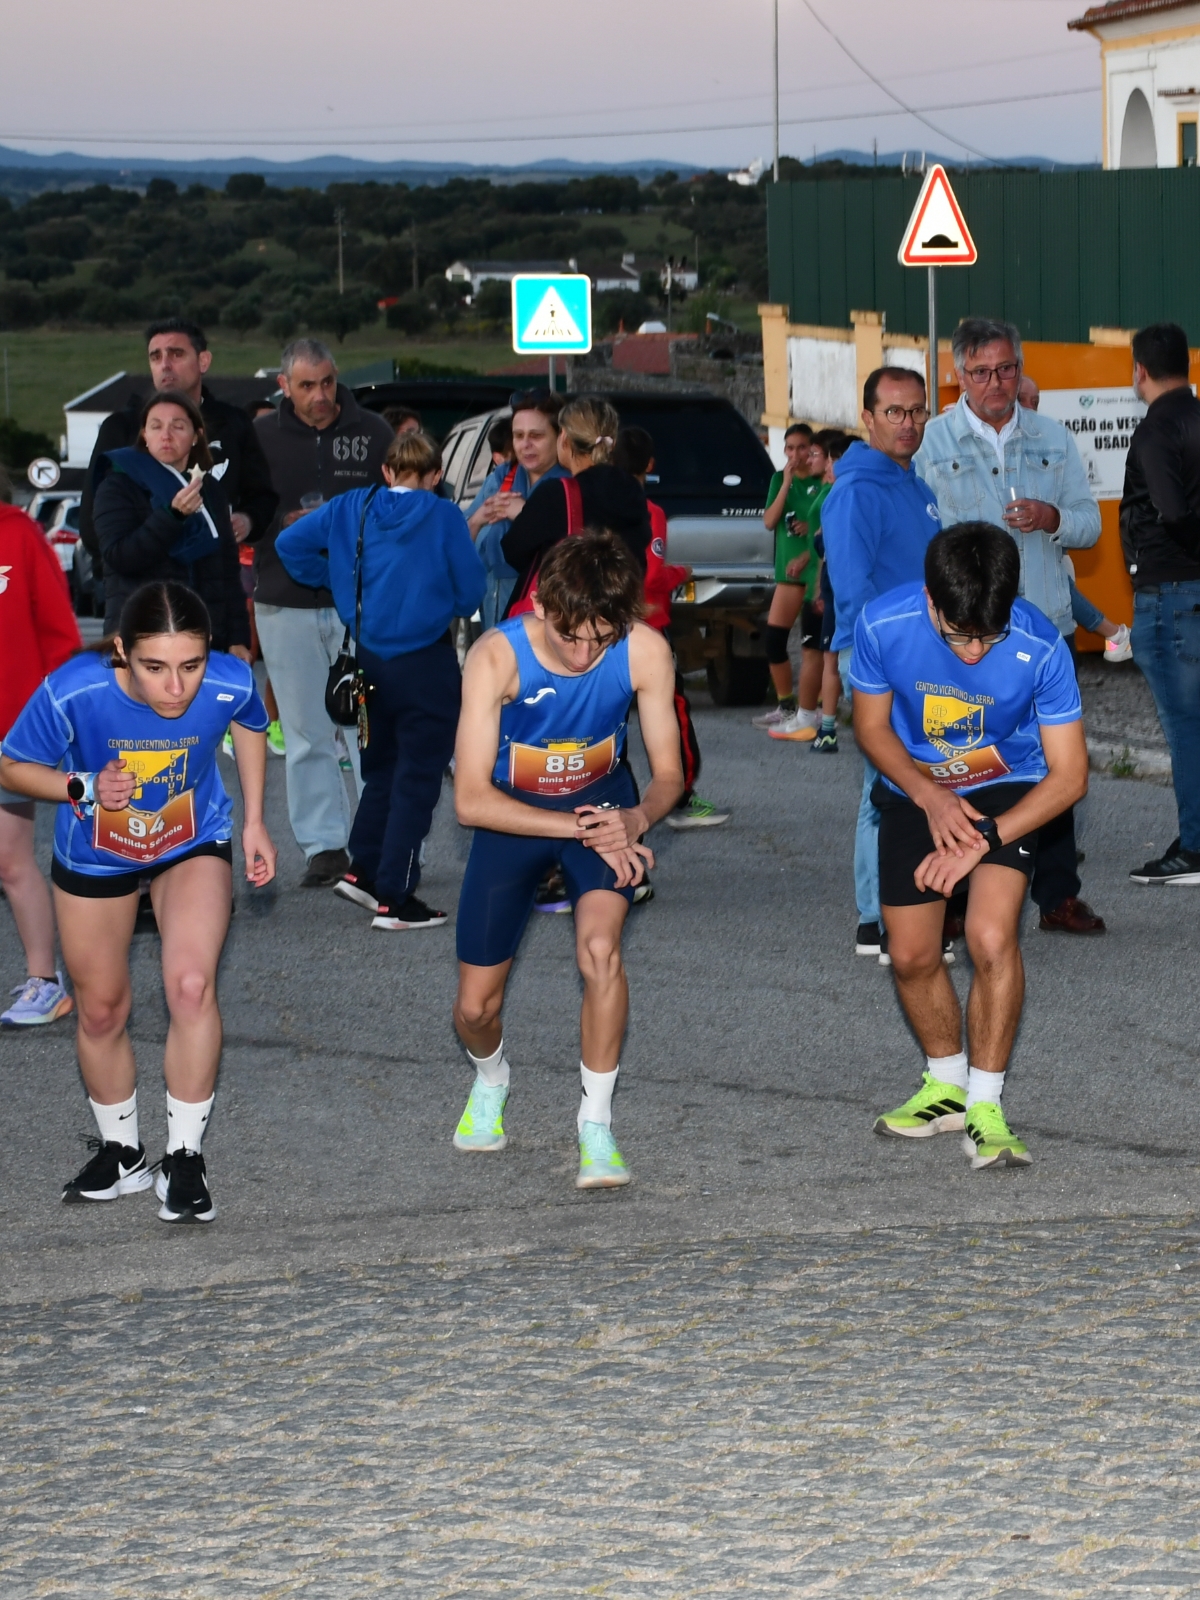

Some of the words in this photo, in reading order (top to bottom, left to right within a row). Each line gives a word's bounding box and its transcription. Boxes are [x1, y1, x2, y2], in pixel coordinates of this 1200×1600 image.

[1099, 419, 1113, 431] de
[1094, 434, 1131, 450] USAD
[915, 681, 938, 694] CENTRO
[939, 684, 968, 701] VICENTINO
[975, 694, 995, 706] SERRA
[926, 718, 980, 731] DESPORTO
[107, 738, 134, 750] CENTRO
[135, 738, 170, 750] VICENTINO
[178, 735, 199, 748] SERRA
[545, 753, 585, 773] 85
[929, 761, 970, 778] 86
[137, 774, 183, 784] SPORTO
[565, 772, 591, 782] Pinto
[968, 768, 994, 780] Pires
[128, 814, 165, 838] 94
[109, 831, 147, 849] Matilde
